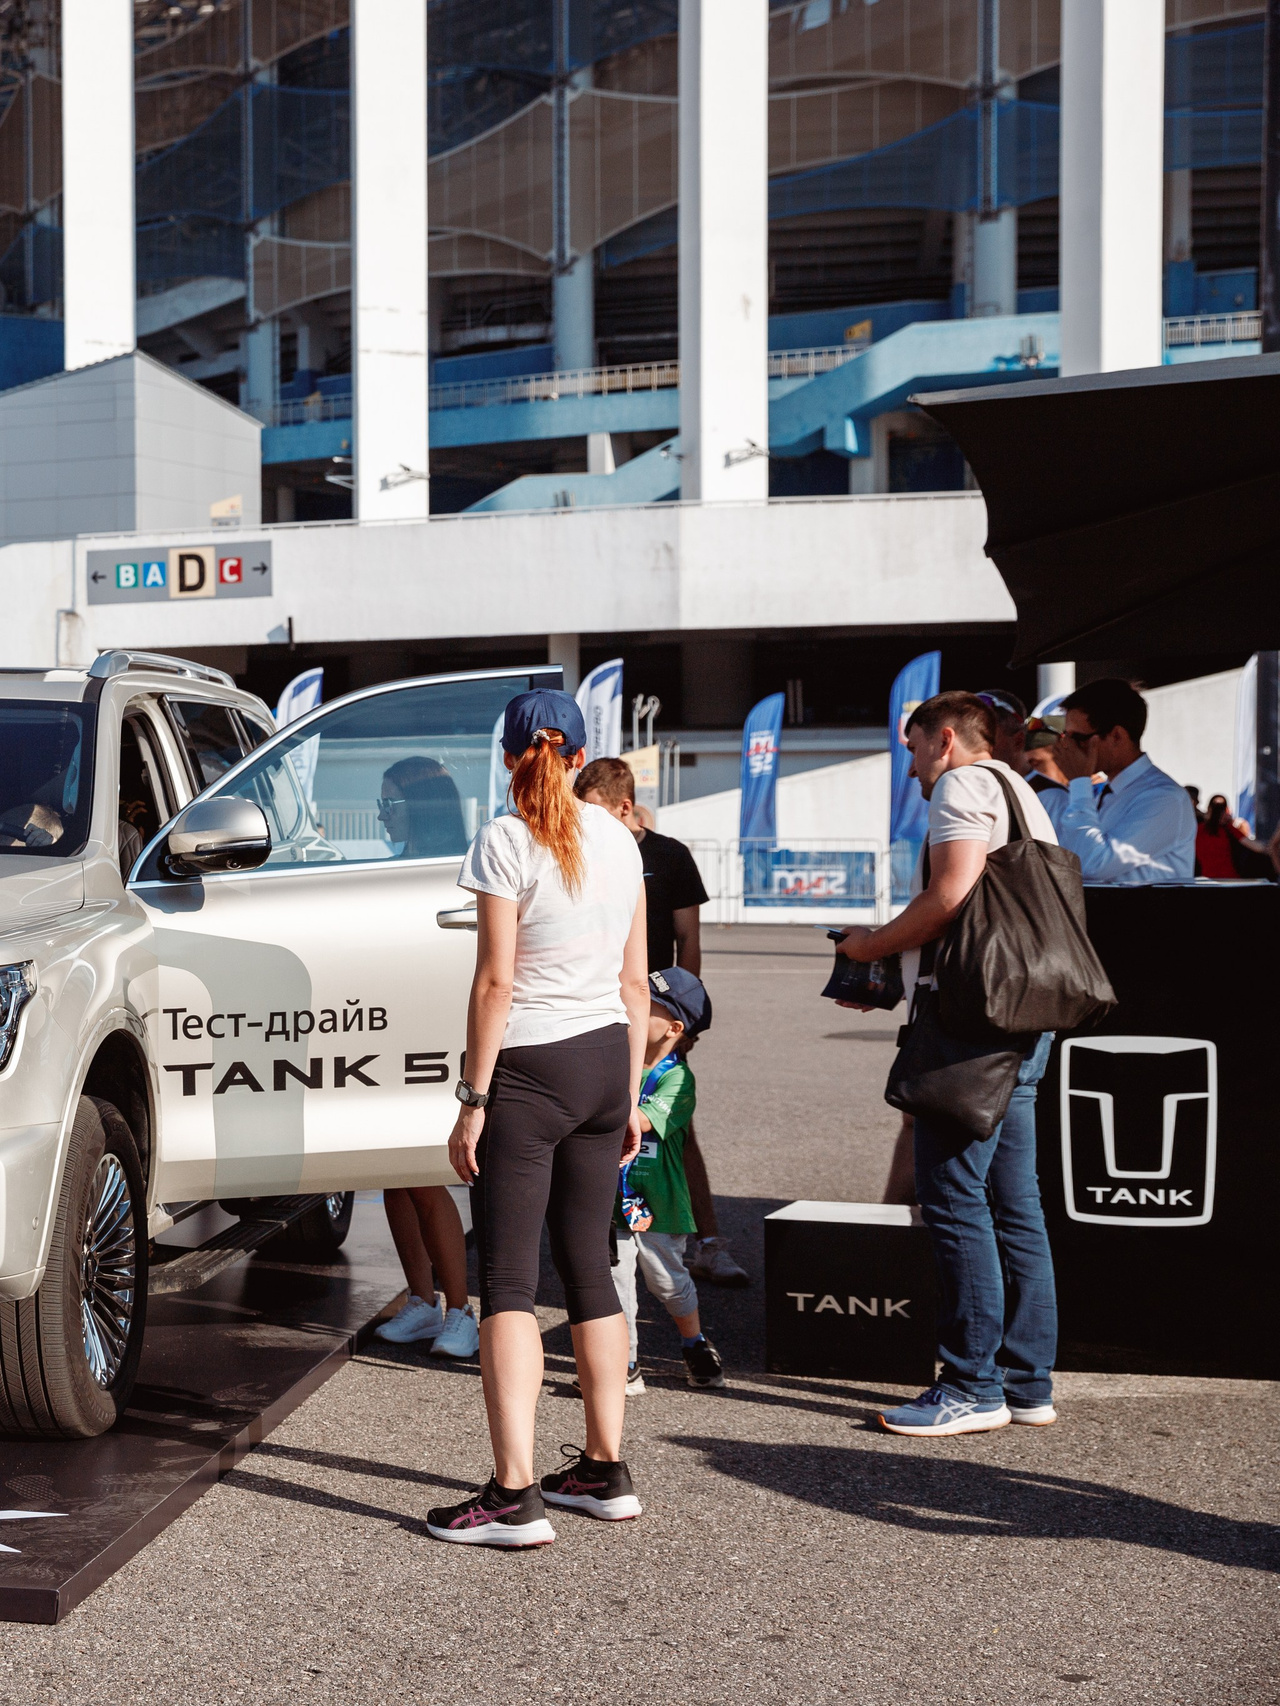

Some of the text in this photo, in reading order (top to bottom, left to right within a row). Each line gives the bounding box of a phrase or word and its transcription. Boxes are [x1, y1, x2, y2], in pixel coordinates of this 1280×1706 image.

[119, 554, 238, 592] B A D C
[162, 999, 389, 1043] Тест-драйв
[162, 1050, 466, 1097] TANK 5
[1086, 1186, 1194, 1206] TANK
[786, 1292, 911, 1319] TANK
